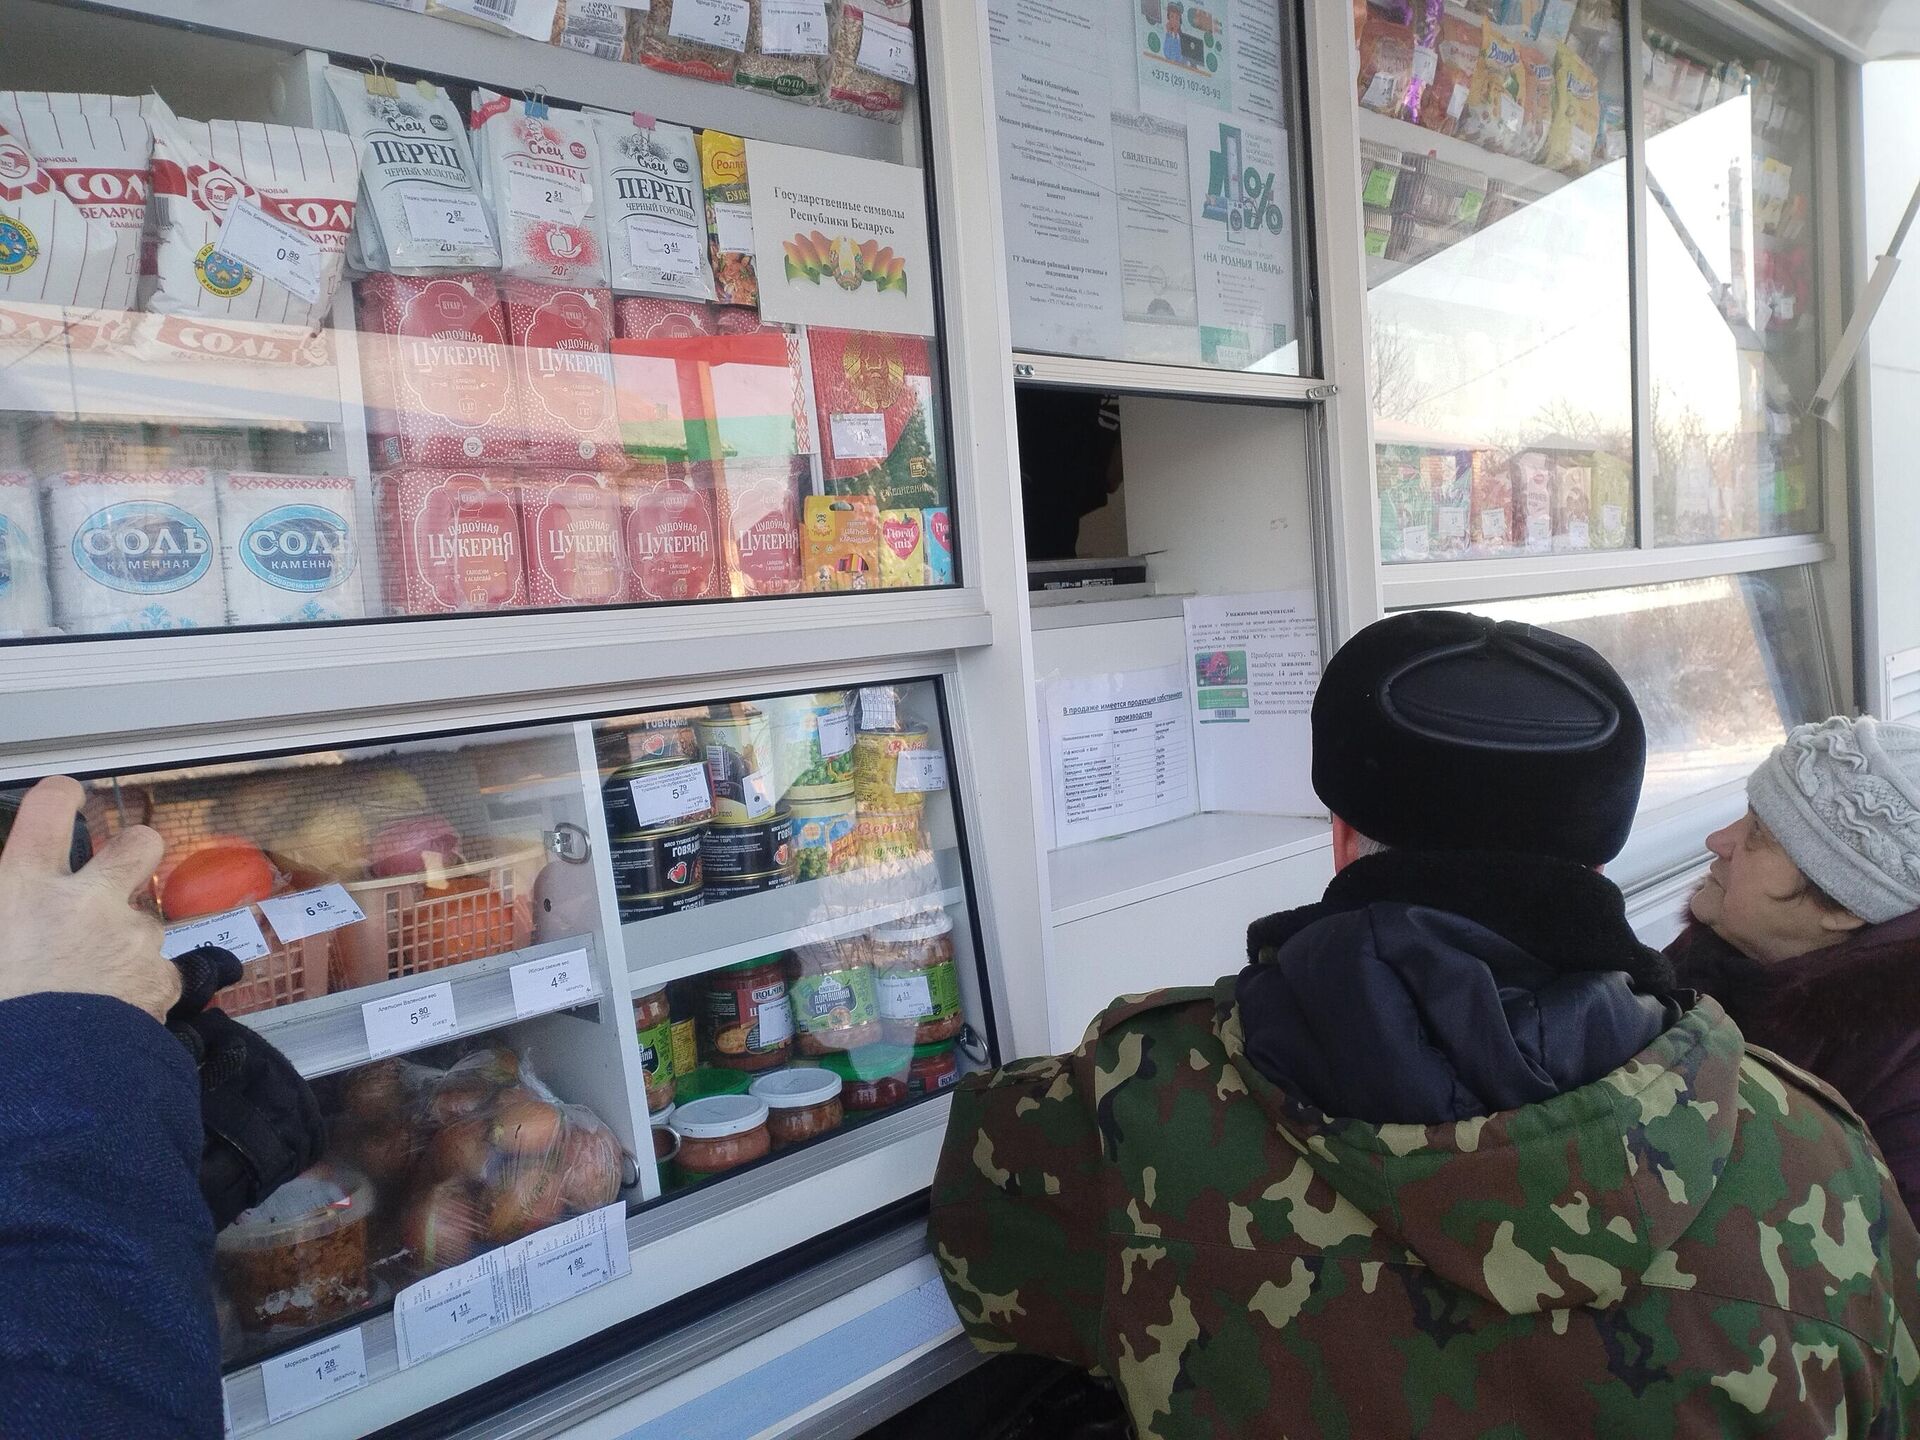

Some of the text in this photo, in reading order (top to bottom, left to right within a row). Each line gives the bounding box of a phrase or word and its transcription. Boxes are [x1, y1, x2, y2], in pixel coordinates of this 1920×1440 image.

[713, 14, 721, 26] 2
[776, 77, 805, 90] КРУПА
[1151, 69, 1222, 99] +375 (29) 107-93-93
[388, 119, 425, 133] Спец
[370, 140, 467, 177] ПЕРЕЦ
[529, 141, 564, 160] Спец
[637, 155, 668, 175] Спец
[1121, 151, 1180, 170] СВИДЕТЕЛЬСТВО
[384, 167, 467, 183] ЧЕРНЫЙ МОЛОТЫЙ
[545, 190, 562, 203] 2 51
[615, 177, 696, 217] ПЕРЕЦ
[774, 186, 906, 220] Государственные символы
[237, 204, 253, 217] Соль
[446, 212, 455, 224] 2
[626, 203, 695, 222] ЧЕРНЫЙ ГОРОШЕК
[790, 207, 896, 236] Республики Беларусь
[276, 248, 301, 262] 0 89
[664, 242, 678, 254] 3 41
[1220, 255, 1253, 271] РОДНЫЯ
[179, 327, 280, 361] СОЛЬ
[431, 328, 484, 345] ЦУДОЎНАЯ
[555, 337, 600, 354] ЦУДОЎНАЯ
[411, 342, 501, 373] ЦУКЕРНЯ
[448, 520, 500, 537] ЦУДОЎНАЯ
[566, 518, 609, 533] ЦУДОЎНАЯ
[655, 520, 698, 535] ЦУДОЎНАЯ
[754, 518, 791, 531] ЦУДОЎНАЯ
[885, 526, 916, 540] Floral
[81, 527, 209, 555] СОЛЬ
[427, 531, 515, 567] ЦУКЕРНЯ
[548, 529, 619, 561] ЦУКЕРНЯ
[638, 530, 709, 561] ЦУКЕРНЯ
[739, 529, 800, 557] ЦУКЕРНЯ
[894, 539, 914, 550] mix
[107, 560, 191, 570] КАМЕННАЯ
[1062, 706, 1068, 715] В
[1068, 703, 1100, 717] продаже
[1100, 700, 1127, 711] имеется
[1127, 696, 1157, 709] продукция
[1114, 710, 1153, 724] производства
[672, 784, 688, 800] 5 79
[305, 900, 330, 917] 6 62
[217, 931, 230, 942] 37
[550, 971, 567, 988] 4 29
[754, 983, 785, 1000] ROLNIK
[814, 987, 851, 1004] ДОМАШНИЙ
[897, 994, 902, 1002] 4
[410, 1006, 430, 1026] 5 80
[815, 1003, 828, 1015] СУП
[567, 1257, 584, 1277] 1 60
[450, 1302, 469, 1323] 1 11
[284, 1357, 310, 1369] Морковь
[315, 1358, 336, 1380] 1 28
